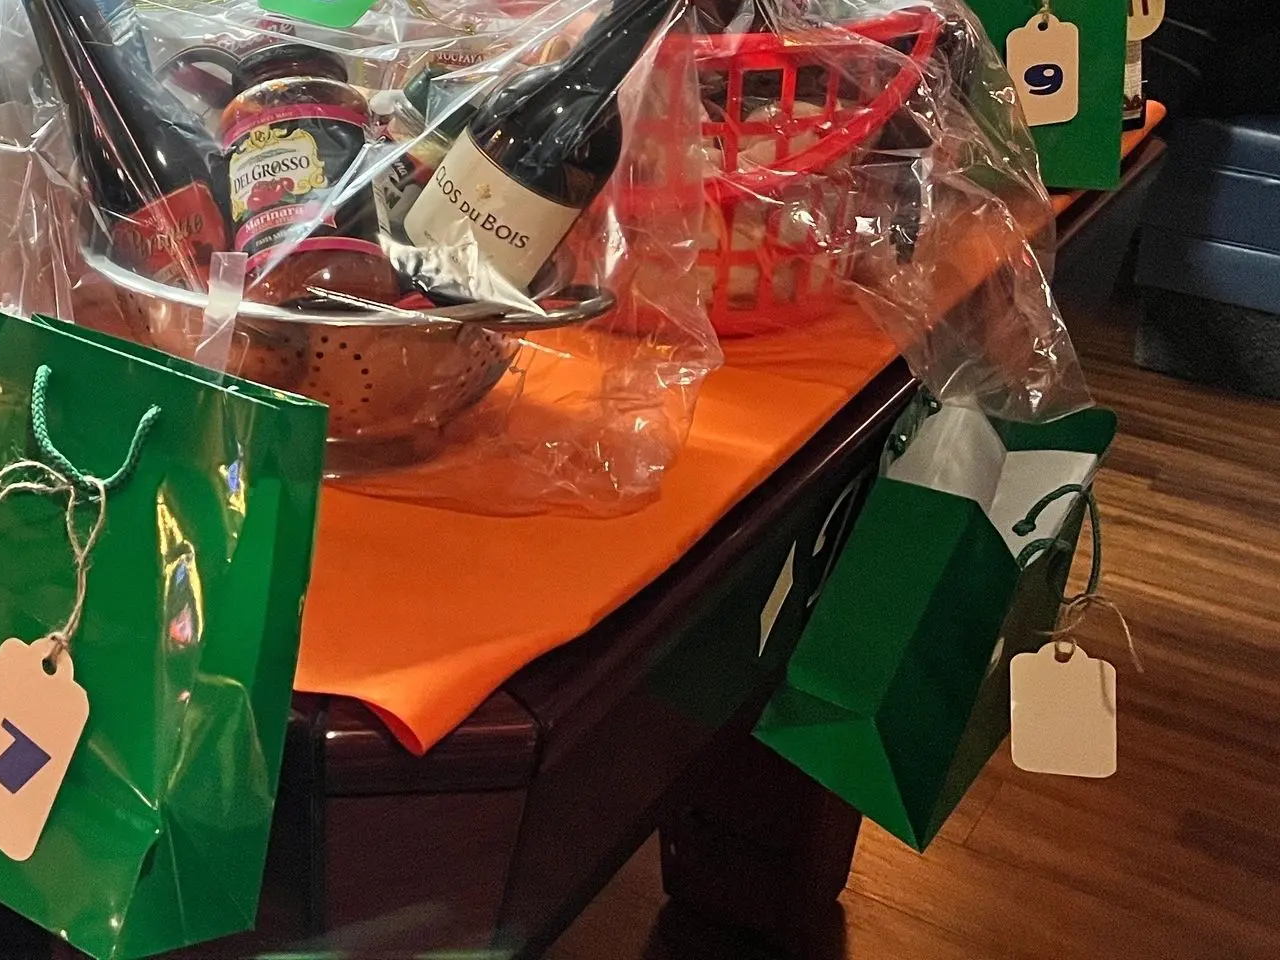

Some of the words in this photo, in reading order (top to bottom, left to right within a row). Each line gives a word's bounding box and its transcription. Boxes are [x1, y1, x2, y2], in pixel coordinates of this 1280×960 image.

[1023, 63, 1064, 96] 9
[245, 206, 304, 233] Marinara
[436, 165, 462, 204] CLOS
[480, 213, 531, 249] BOIS
